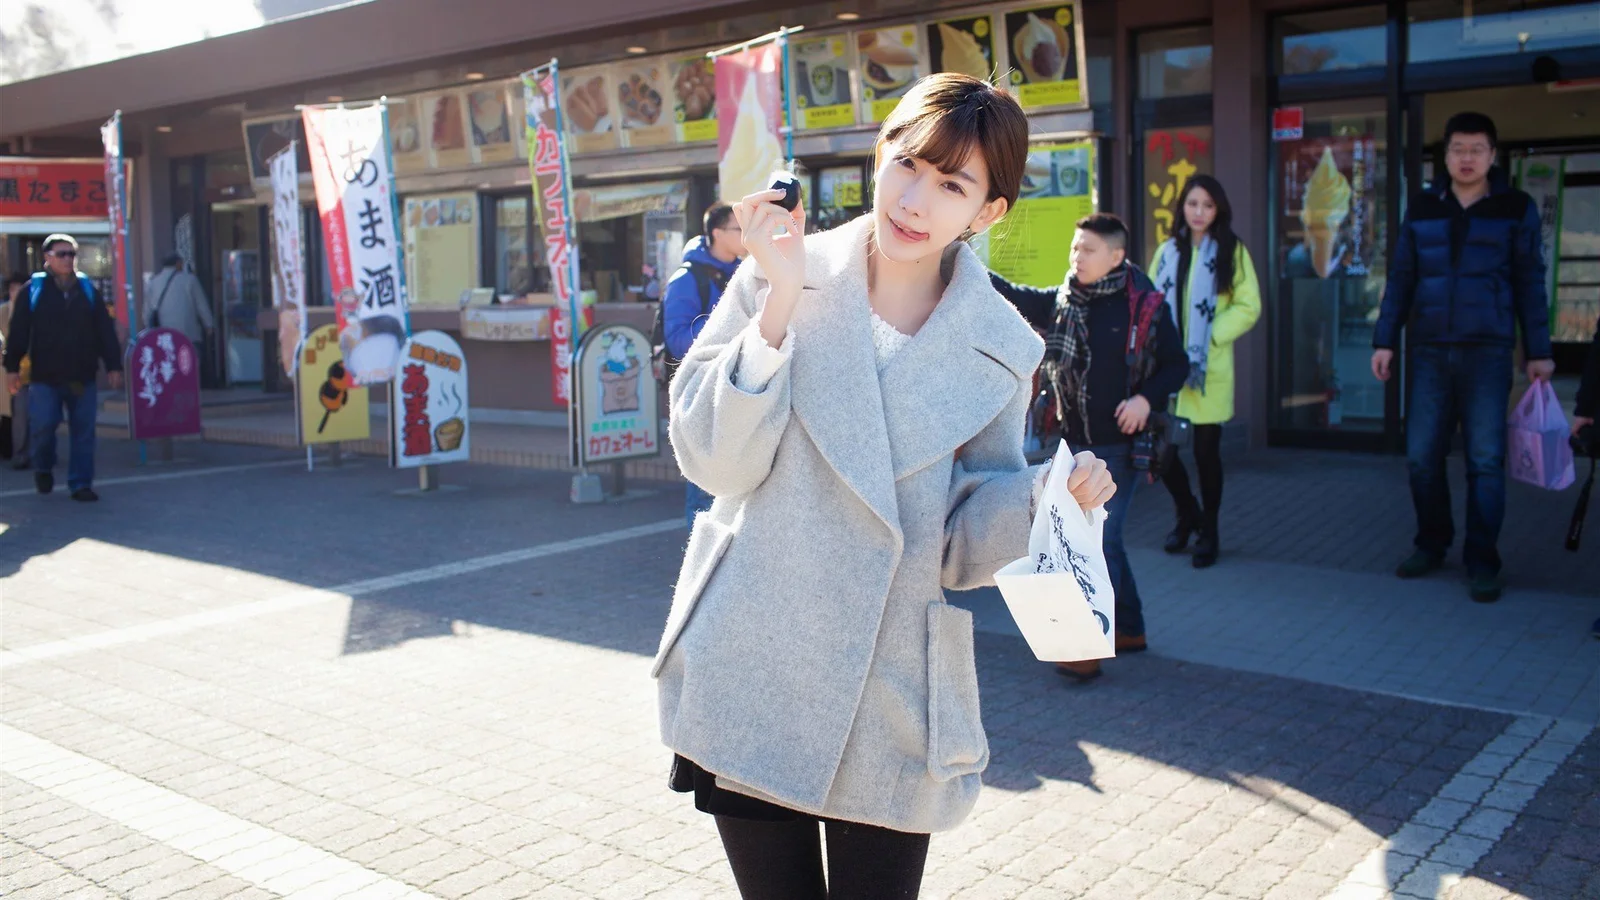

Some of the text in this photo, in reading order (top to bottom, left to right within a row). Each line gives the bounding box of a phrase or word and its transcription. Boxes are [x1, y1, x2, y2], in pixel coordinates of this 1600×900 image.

[340, 139, 397, 308] あま酒
[589, 430, 655, 457] カフェオーレ
